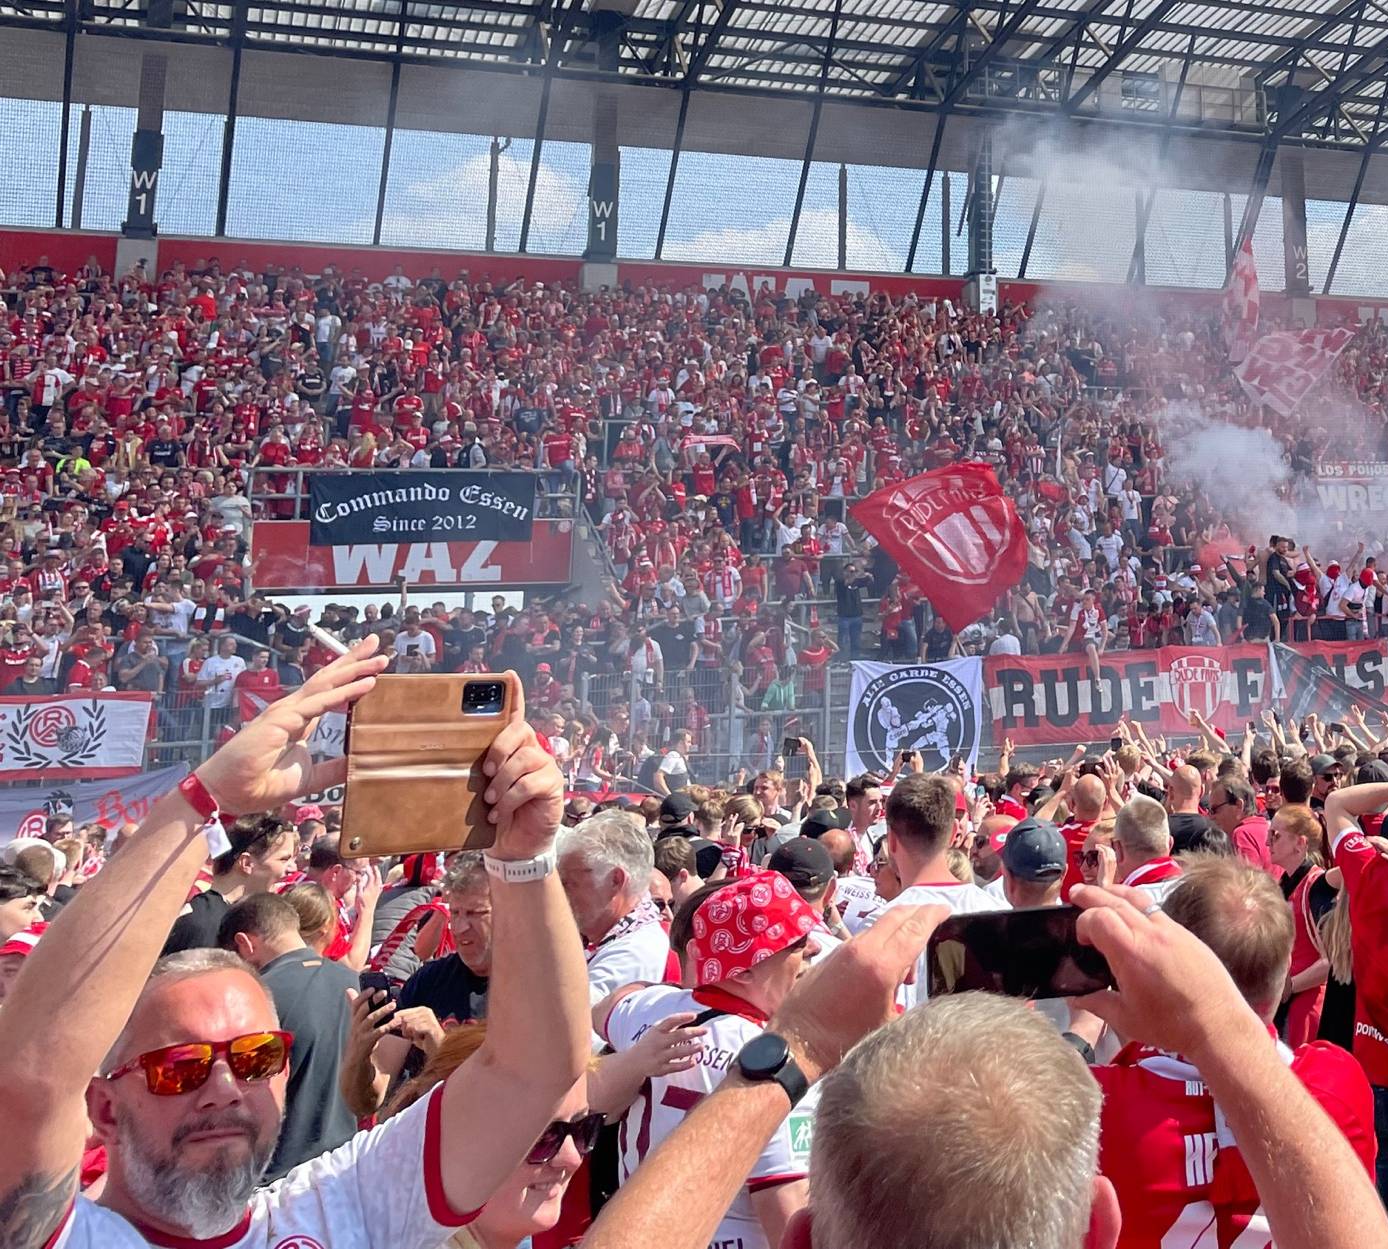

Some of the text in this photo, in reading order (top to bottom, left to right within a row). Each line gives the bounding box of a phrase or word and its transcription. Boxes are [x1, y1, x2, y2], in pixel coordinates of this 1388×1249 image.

[1317, 464, 1344, 477] LOS
[315, 482, 529, 524] Commando Essen
[371, 514, 477, 533] Since 2012
[332, 540, 502, 584] WAZ
[888, 668, 939, 681] GARDE
[942, 674, 972, 711] ESSEN
[996, 661, 1160, 729] RUDE
